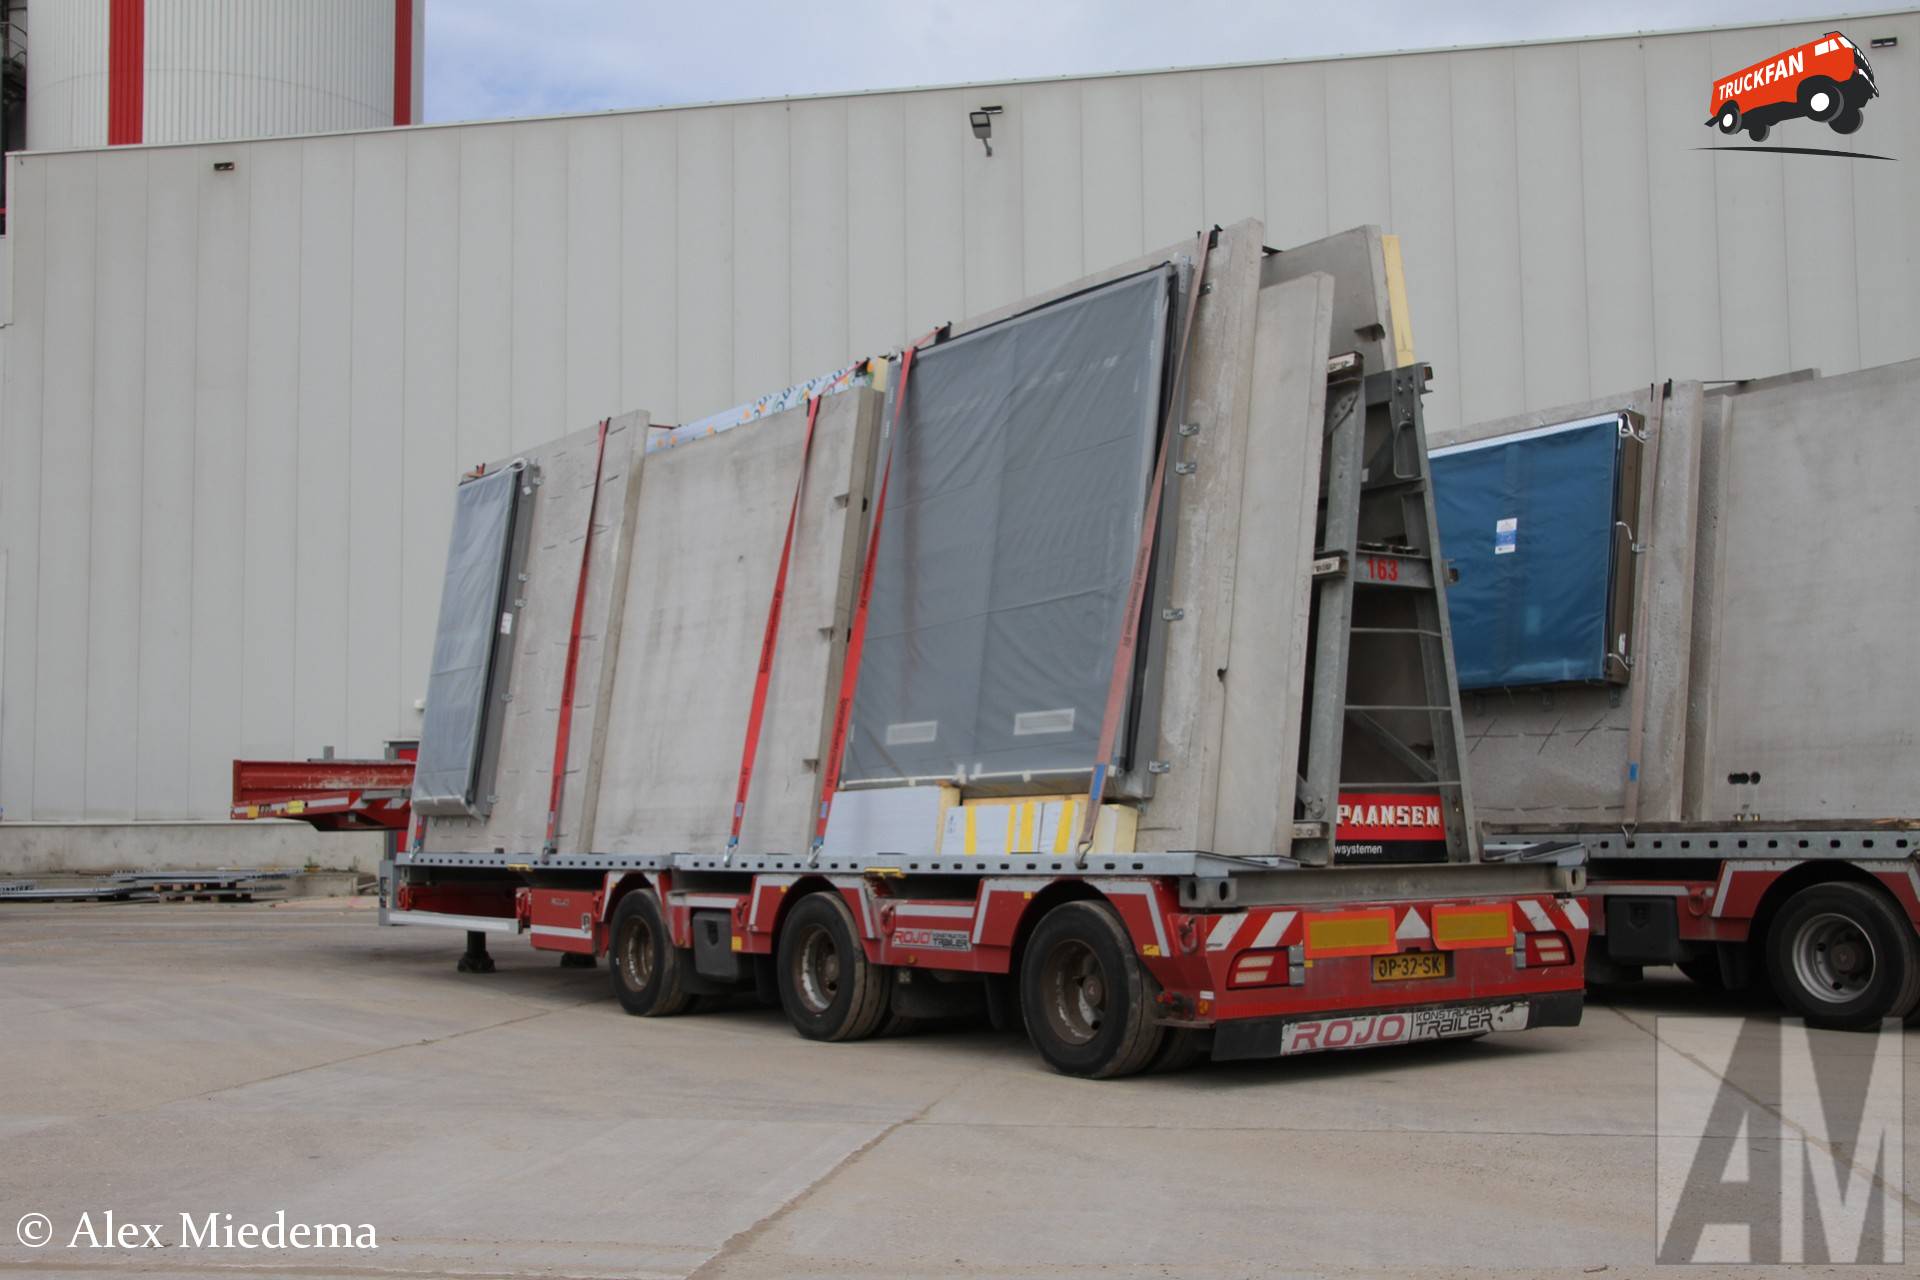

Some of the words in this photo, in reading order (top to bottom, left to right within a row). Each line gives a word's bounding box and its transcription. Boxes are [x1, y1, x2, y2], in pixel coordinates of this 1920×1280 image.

[1368, 559, 1399, 581] 163
[893, 931, 930, 944] ROJO
[1292, 1015, 1405, 1050] ROJO
